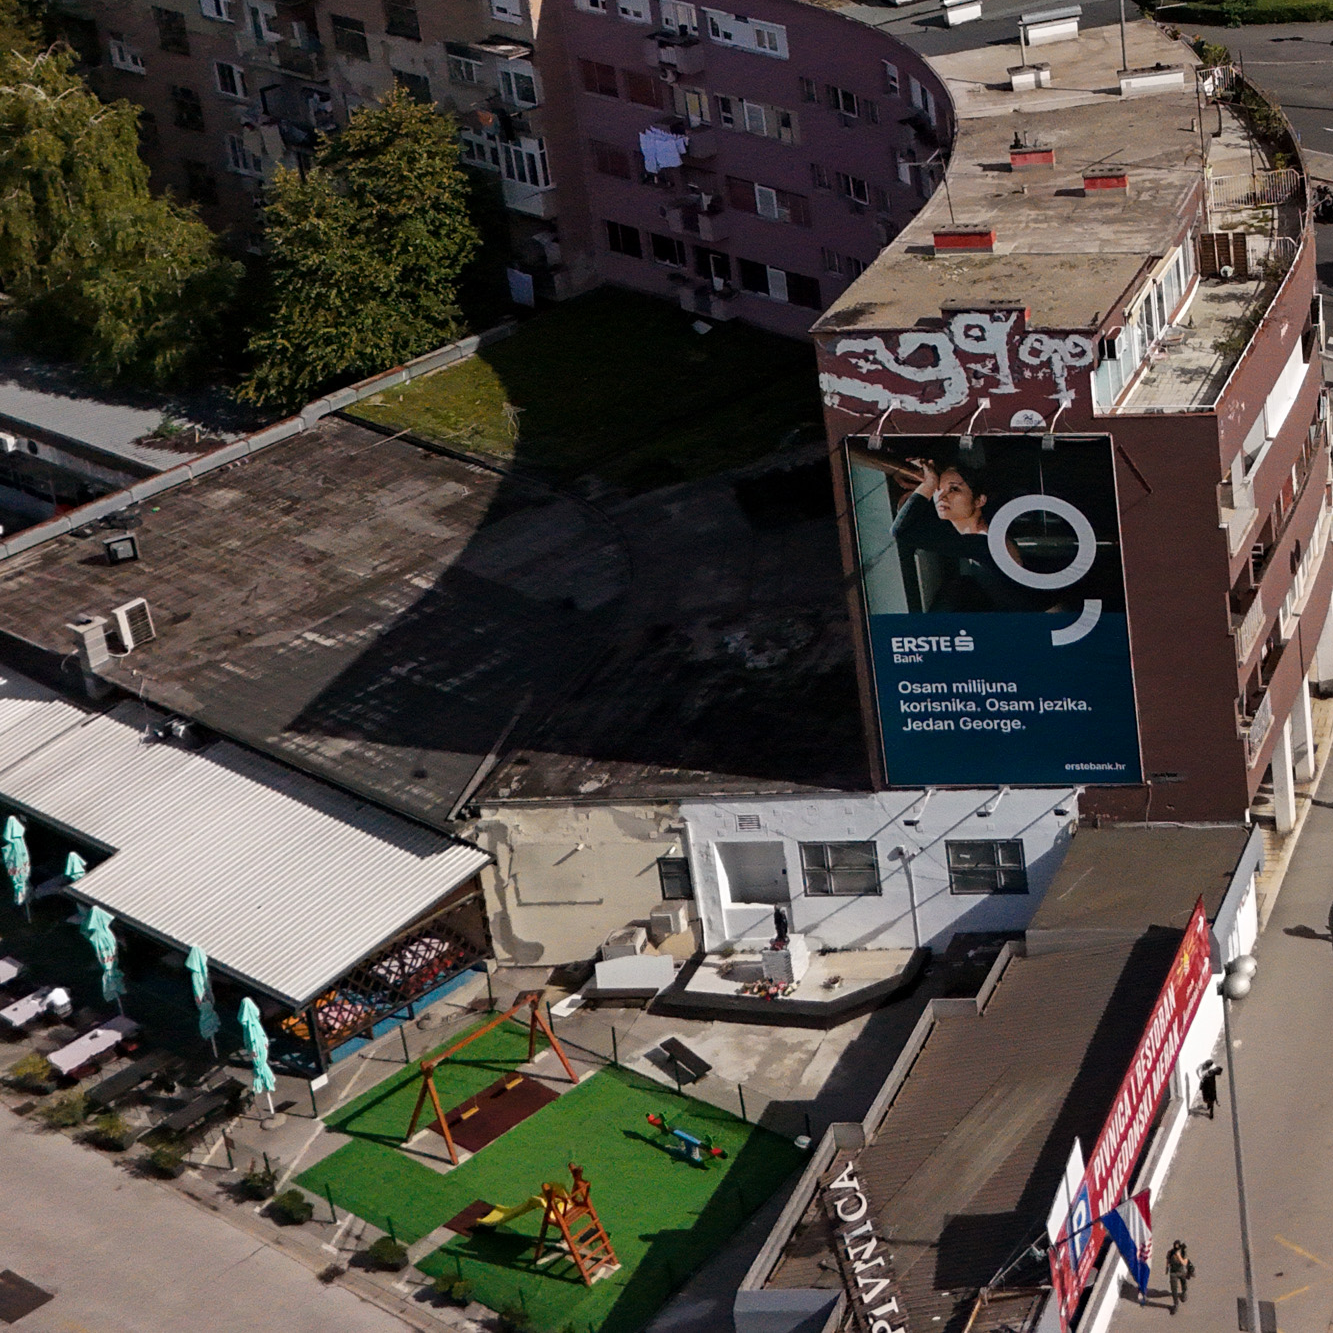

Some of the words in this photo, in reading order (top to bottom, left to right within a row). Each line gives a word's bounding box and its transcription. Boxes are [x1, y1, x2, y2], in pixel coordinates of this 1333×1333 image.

[891, 636, 952, 652] ERSTE
[893, 653, 924, 664] Bank
[898, 680, 948, 694] Osam
[952, 679, 1018, 696] milijuna
[900, 698, 982, 713] korisnika.
[985, 698, 1035, 711] Osam
[1038, 697, 1093, 714] jezika.
[902, 717, 955, 731] Jedan
[959, 717, 1027, 733] George.
[1064, 762, 1126, 771] erstebank.hr
[1094, 1089, 1132, 1190] PIVNICA
[1131, 1076, 1137, 1105] I
[1135, 981, 1176, 1093] RESTORAN
[1098, 1083, 1152, 1217] MAKEDONSKI
[1152, 1016, 1180, 1101] MERAK
